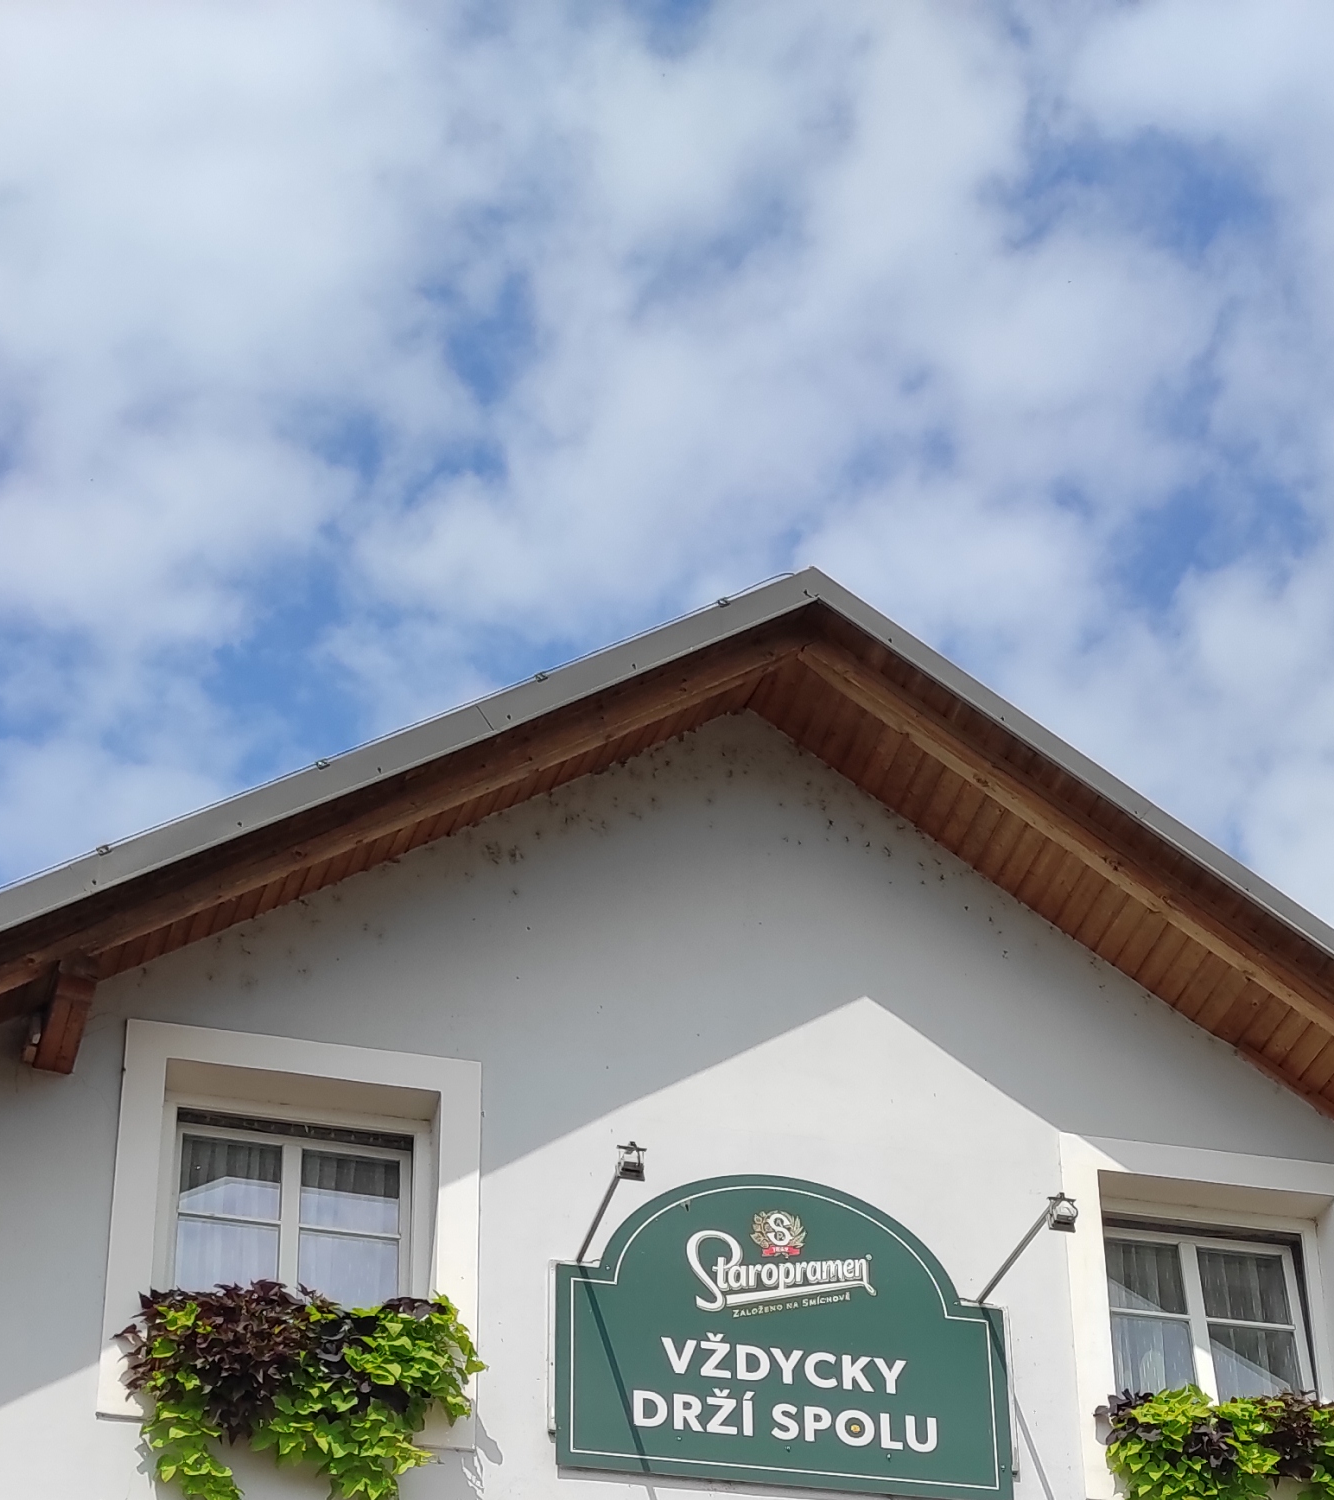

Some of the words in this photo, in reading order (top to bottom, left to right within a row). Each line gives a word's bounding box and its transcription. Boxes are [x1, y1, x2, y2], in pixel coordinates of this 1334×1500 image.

[685, 1229, 878, 1312] Staropramen
[660, 1332, 908, 1395] VŽDYCKY
[633, 1388, 756, 1437] DRŽÍ
[770, 1402, 939, 1454] SPOLU
